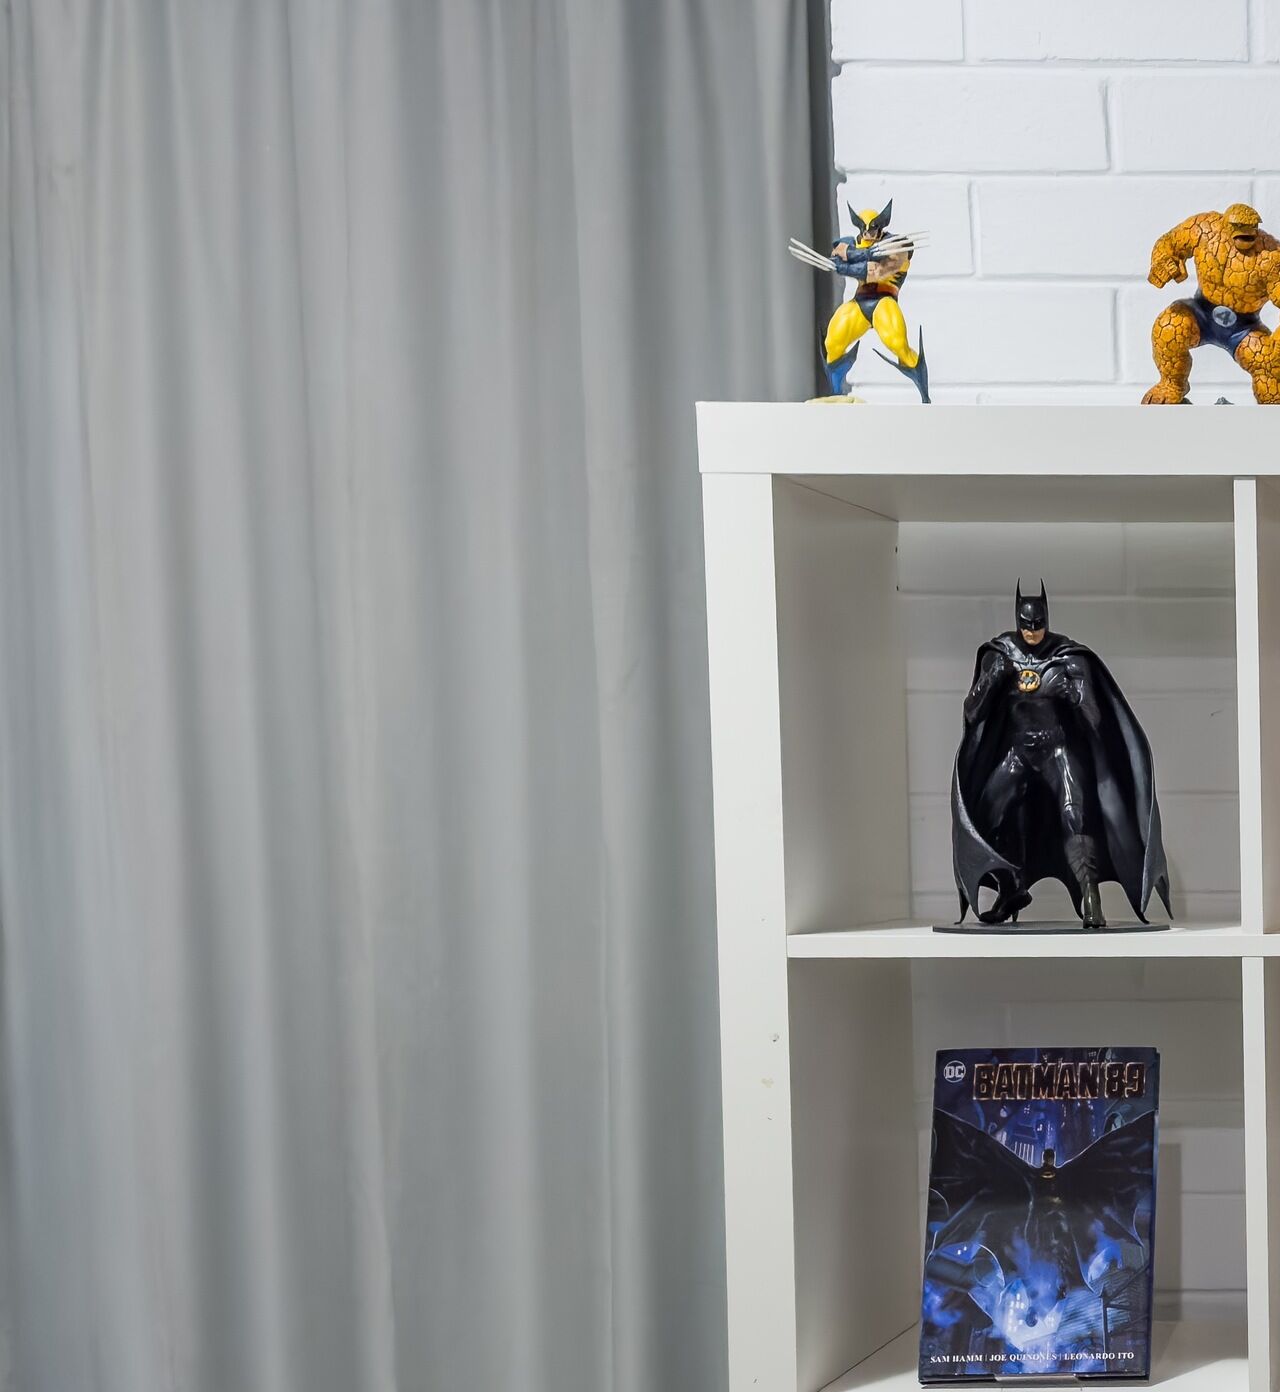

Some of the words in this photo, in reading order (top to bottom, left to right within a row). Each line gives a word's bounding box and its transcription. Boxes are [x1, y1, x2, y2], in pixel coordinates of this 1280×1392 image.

[945, 1065, 965, 1078] DC
[972, 1062, 1099, 1100] BATMAN
[929, 1355, 950, 1364] SAM
[952, 1354, 983, 1363] HAMM
[989, 1353, 1007, 1362] JOE
[1064, 1352, 1115, 1361] LEONARDO
[1117, 1352, 1135, 1360] ITO
